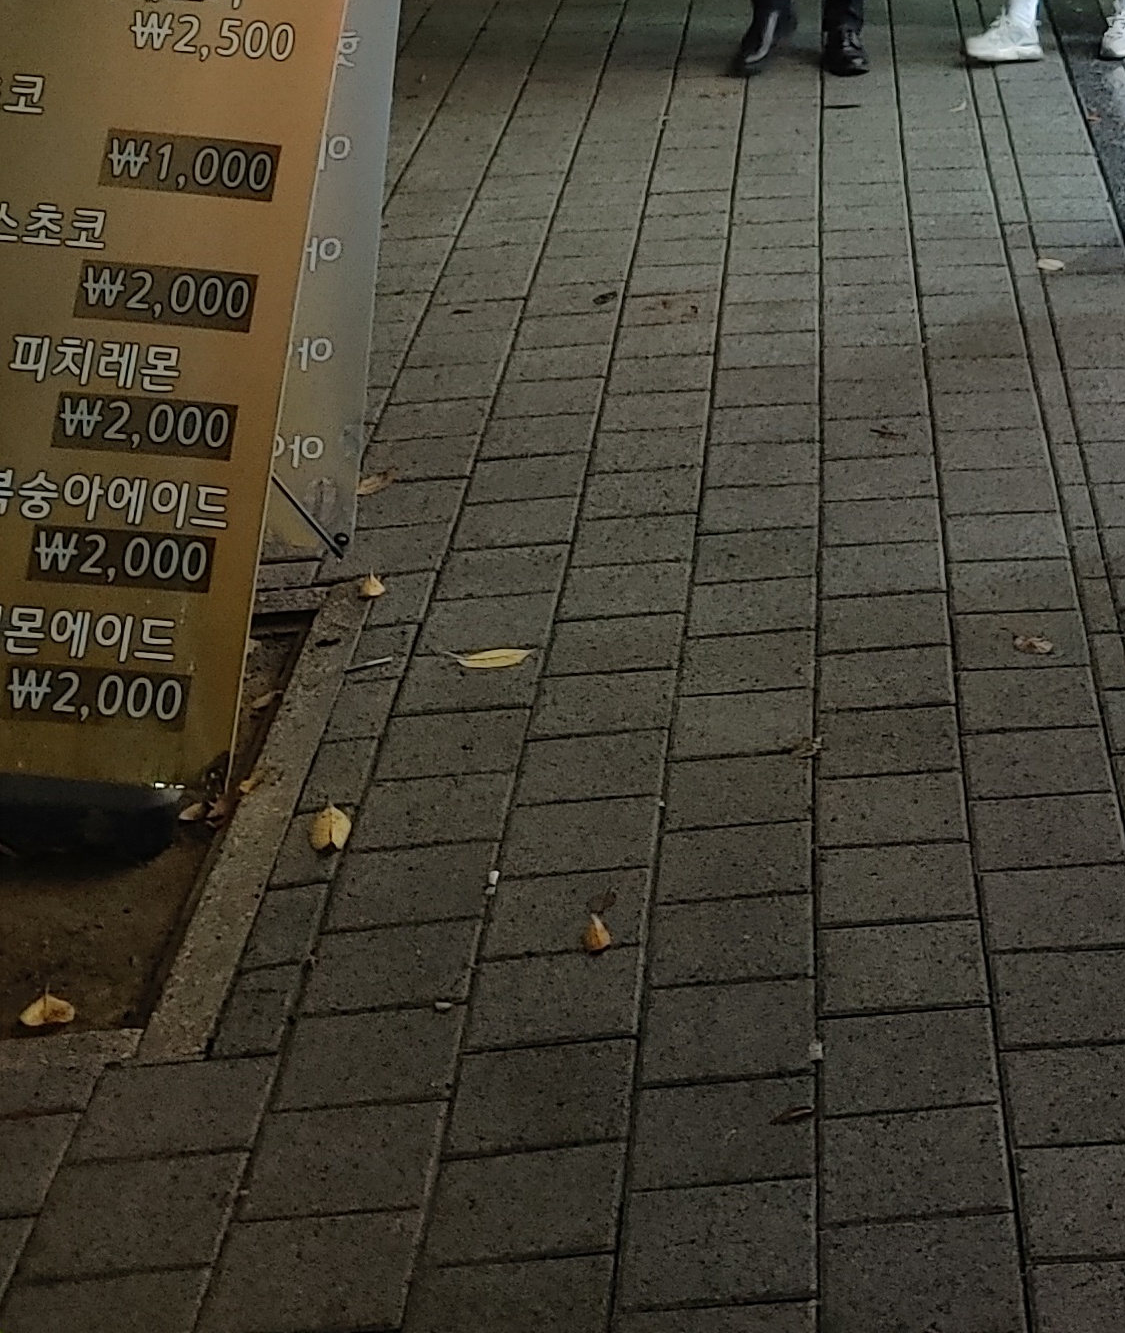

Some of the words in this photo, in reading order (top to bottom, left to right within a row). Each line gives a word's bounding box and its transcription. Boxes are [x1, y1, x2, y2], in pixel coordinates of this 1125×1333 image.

[130, 11, 295, 61] ₩2,500
[107, 138, 273, 192] ₩1,000
[82, 265, 250, 318] ₩2,000
[9, 336, 181, 391] 피치레몬
[59, 395, 230, 447] ₩2,000
[35, 531, 208, 583] ₩2,000
[0, 605, 175, 662] 몬에이드
[7, 669, 183, 721] ₩2,000
